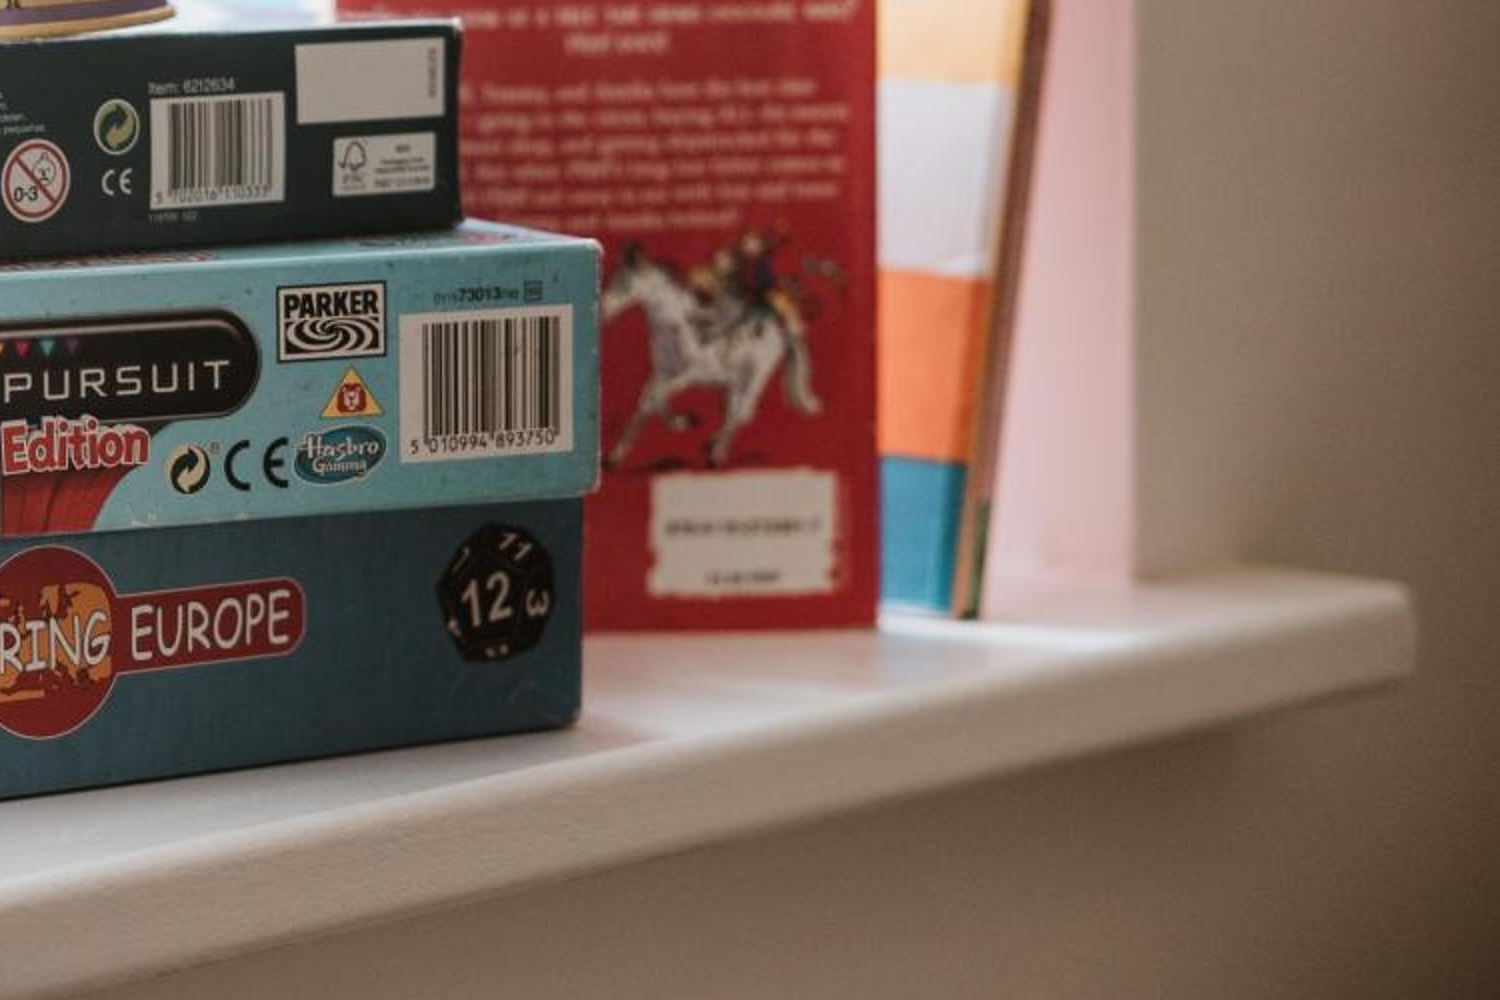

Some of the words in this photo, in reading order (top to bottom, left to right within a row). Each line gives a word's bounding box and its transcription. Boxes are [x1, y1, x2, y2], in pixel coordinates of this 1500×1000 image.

[14, 187, 38, 202] 0-3
[284, 289, 379, 319] PARKER
[4, 359, 230, 404] PURSUIT
[0, 415, 149, 477] Edition
[300, 433, 380, 460] Hasbro
[312, 457, 367, 477] Gaming
[461, 571, 513, 627] 12
[131, 590, 293, 661] EUROPE
